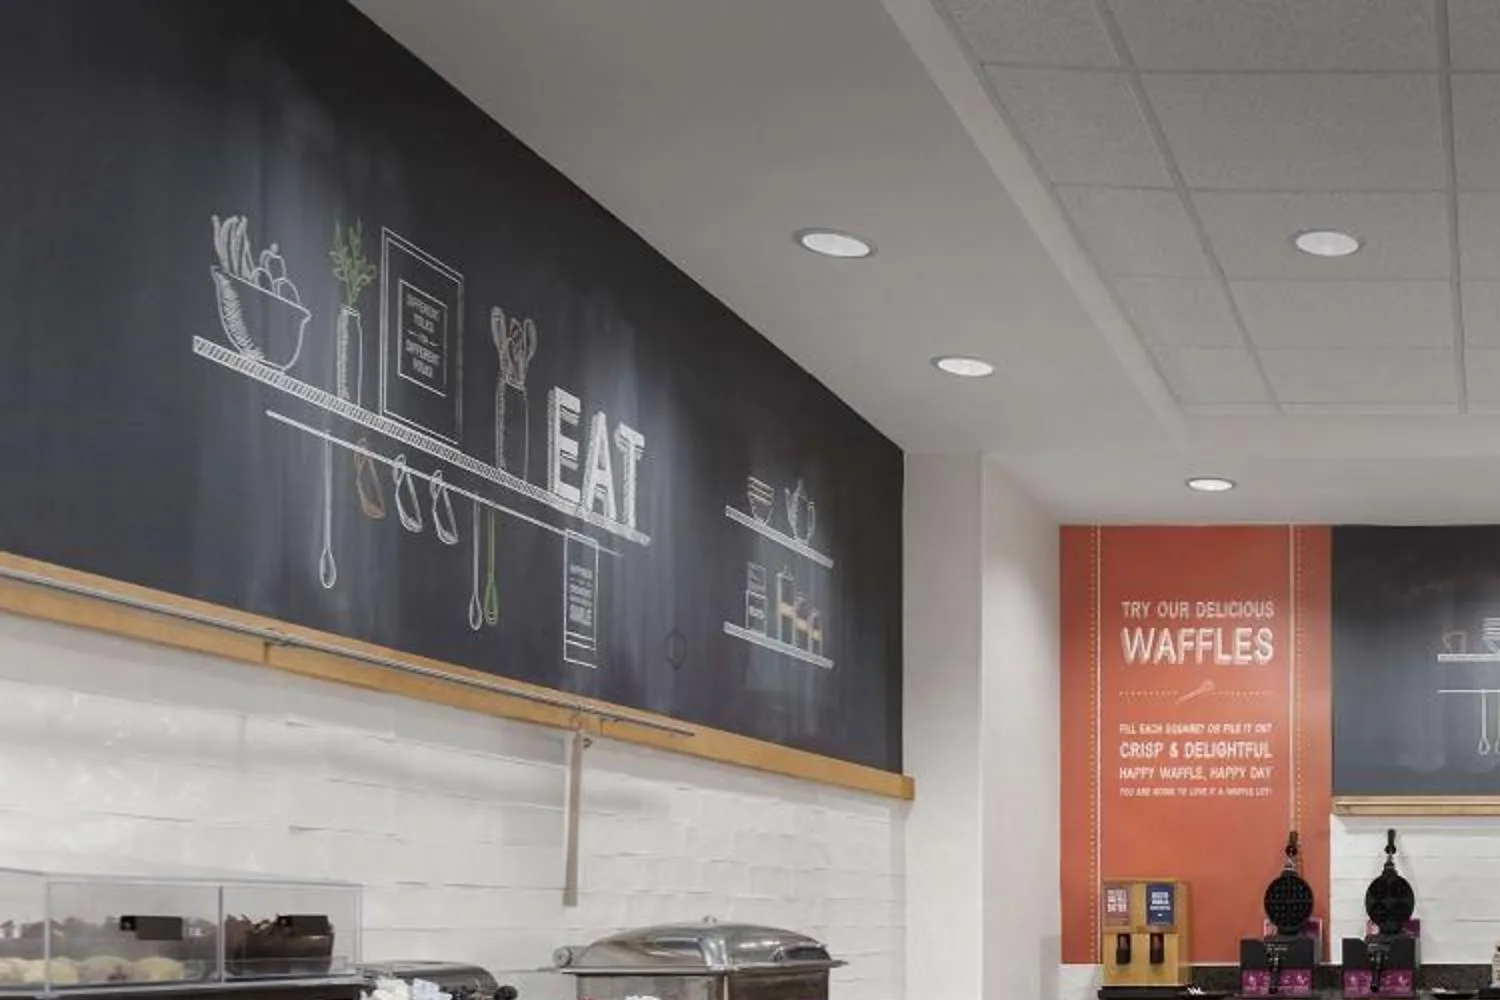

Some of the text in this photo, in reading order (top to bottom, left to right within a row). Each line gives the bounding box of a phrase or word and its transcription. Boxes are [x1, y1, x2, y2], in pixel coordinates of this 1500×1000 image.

[547, 386, 646, 529] EAT
[1121, 601, 1275, 618] TRY OUR DELICIOUS
[1120, 627, 1274, 665] WAFFLES
[1119, 741, 1273, 758] CRISP & DELIGHTFUL
[1119, 767, 1155, 779] HAPPY
[1209, 766, 1247, 779] HAPPY
[1250, 767, 1273, 779] DAY
